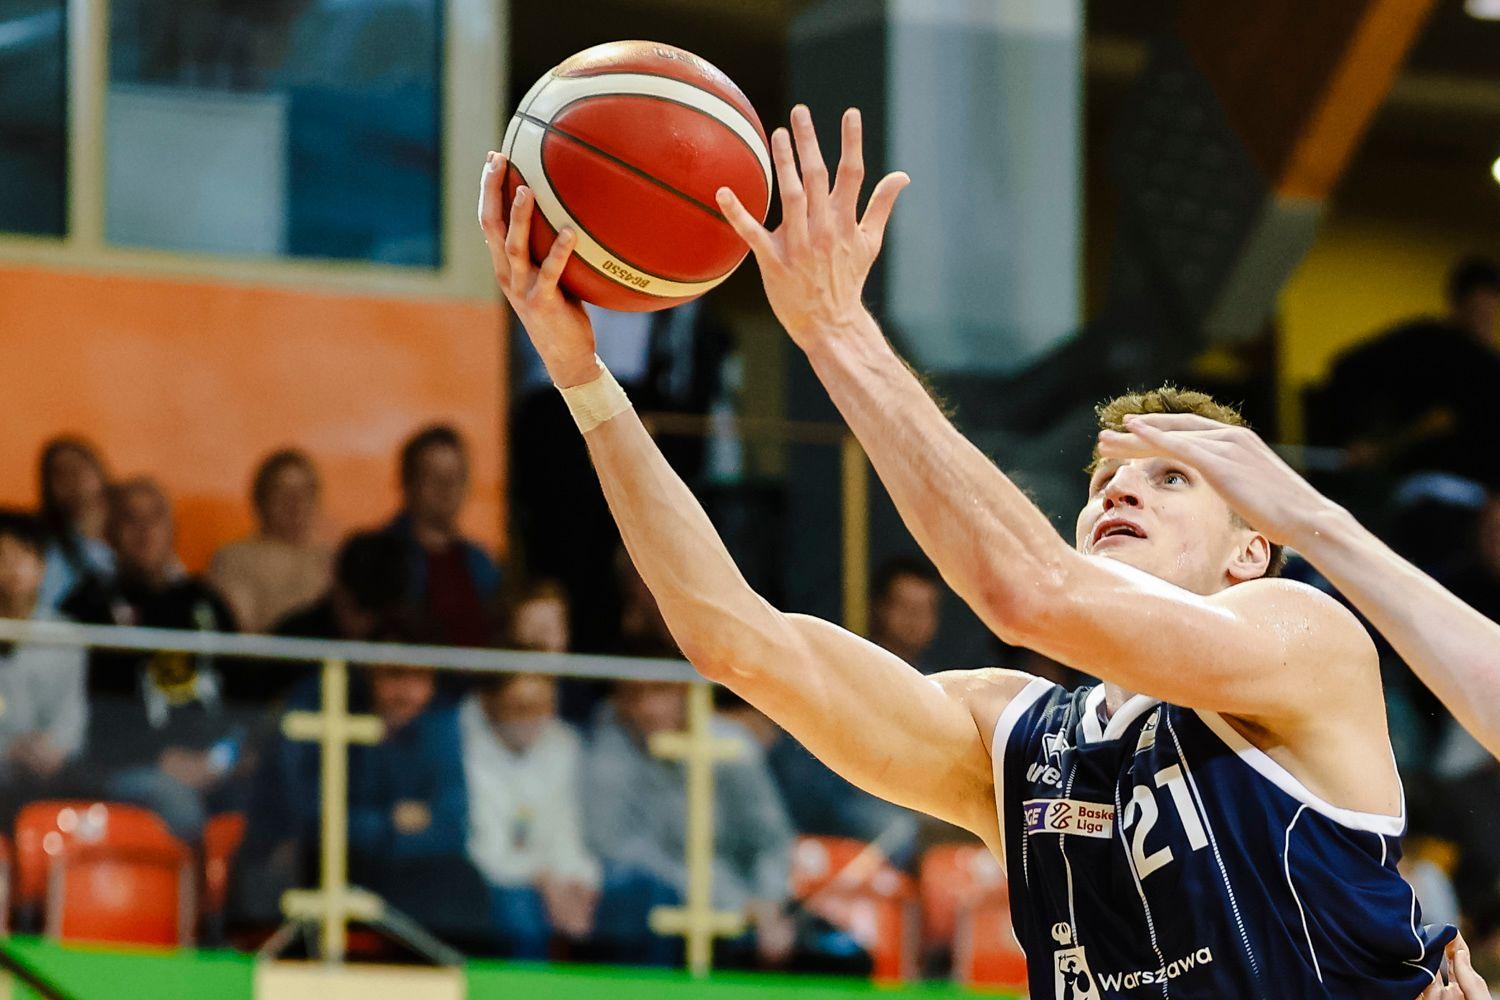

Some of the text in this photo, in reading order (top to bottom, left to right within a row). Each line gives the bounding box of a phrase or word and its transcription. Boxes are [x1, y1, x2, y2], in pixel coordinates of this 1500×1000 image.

[602, 260, 650, 288] BG4550
[1077, 819, 1103, 834] Liga
[1123, 762, 1209, 881] 21
[1098, 946, 1213, 992] Warszawa
